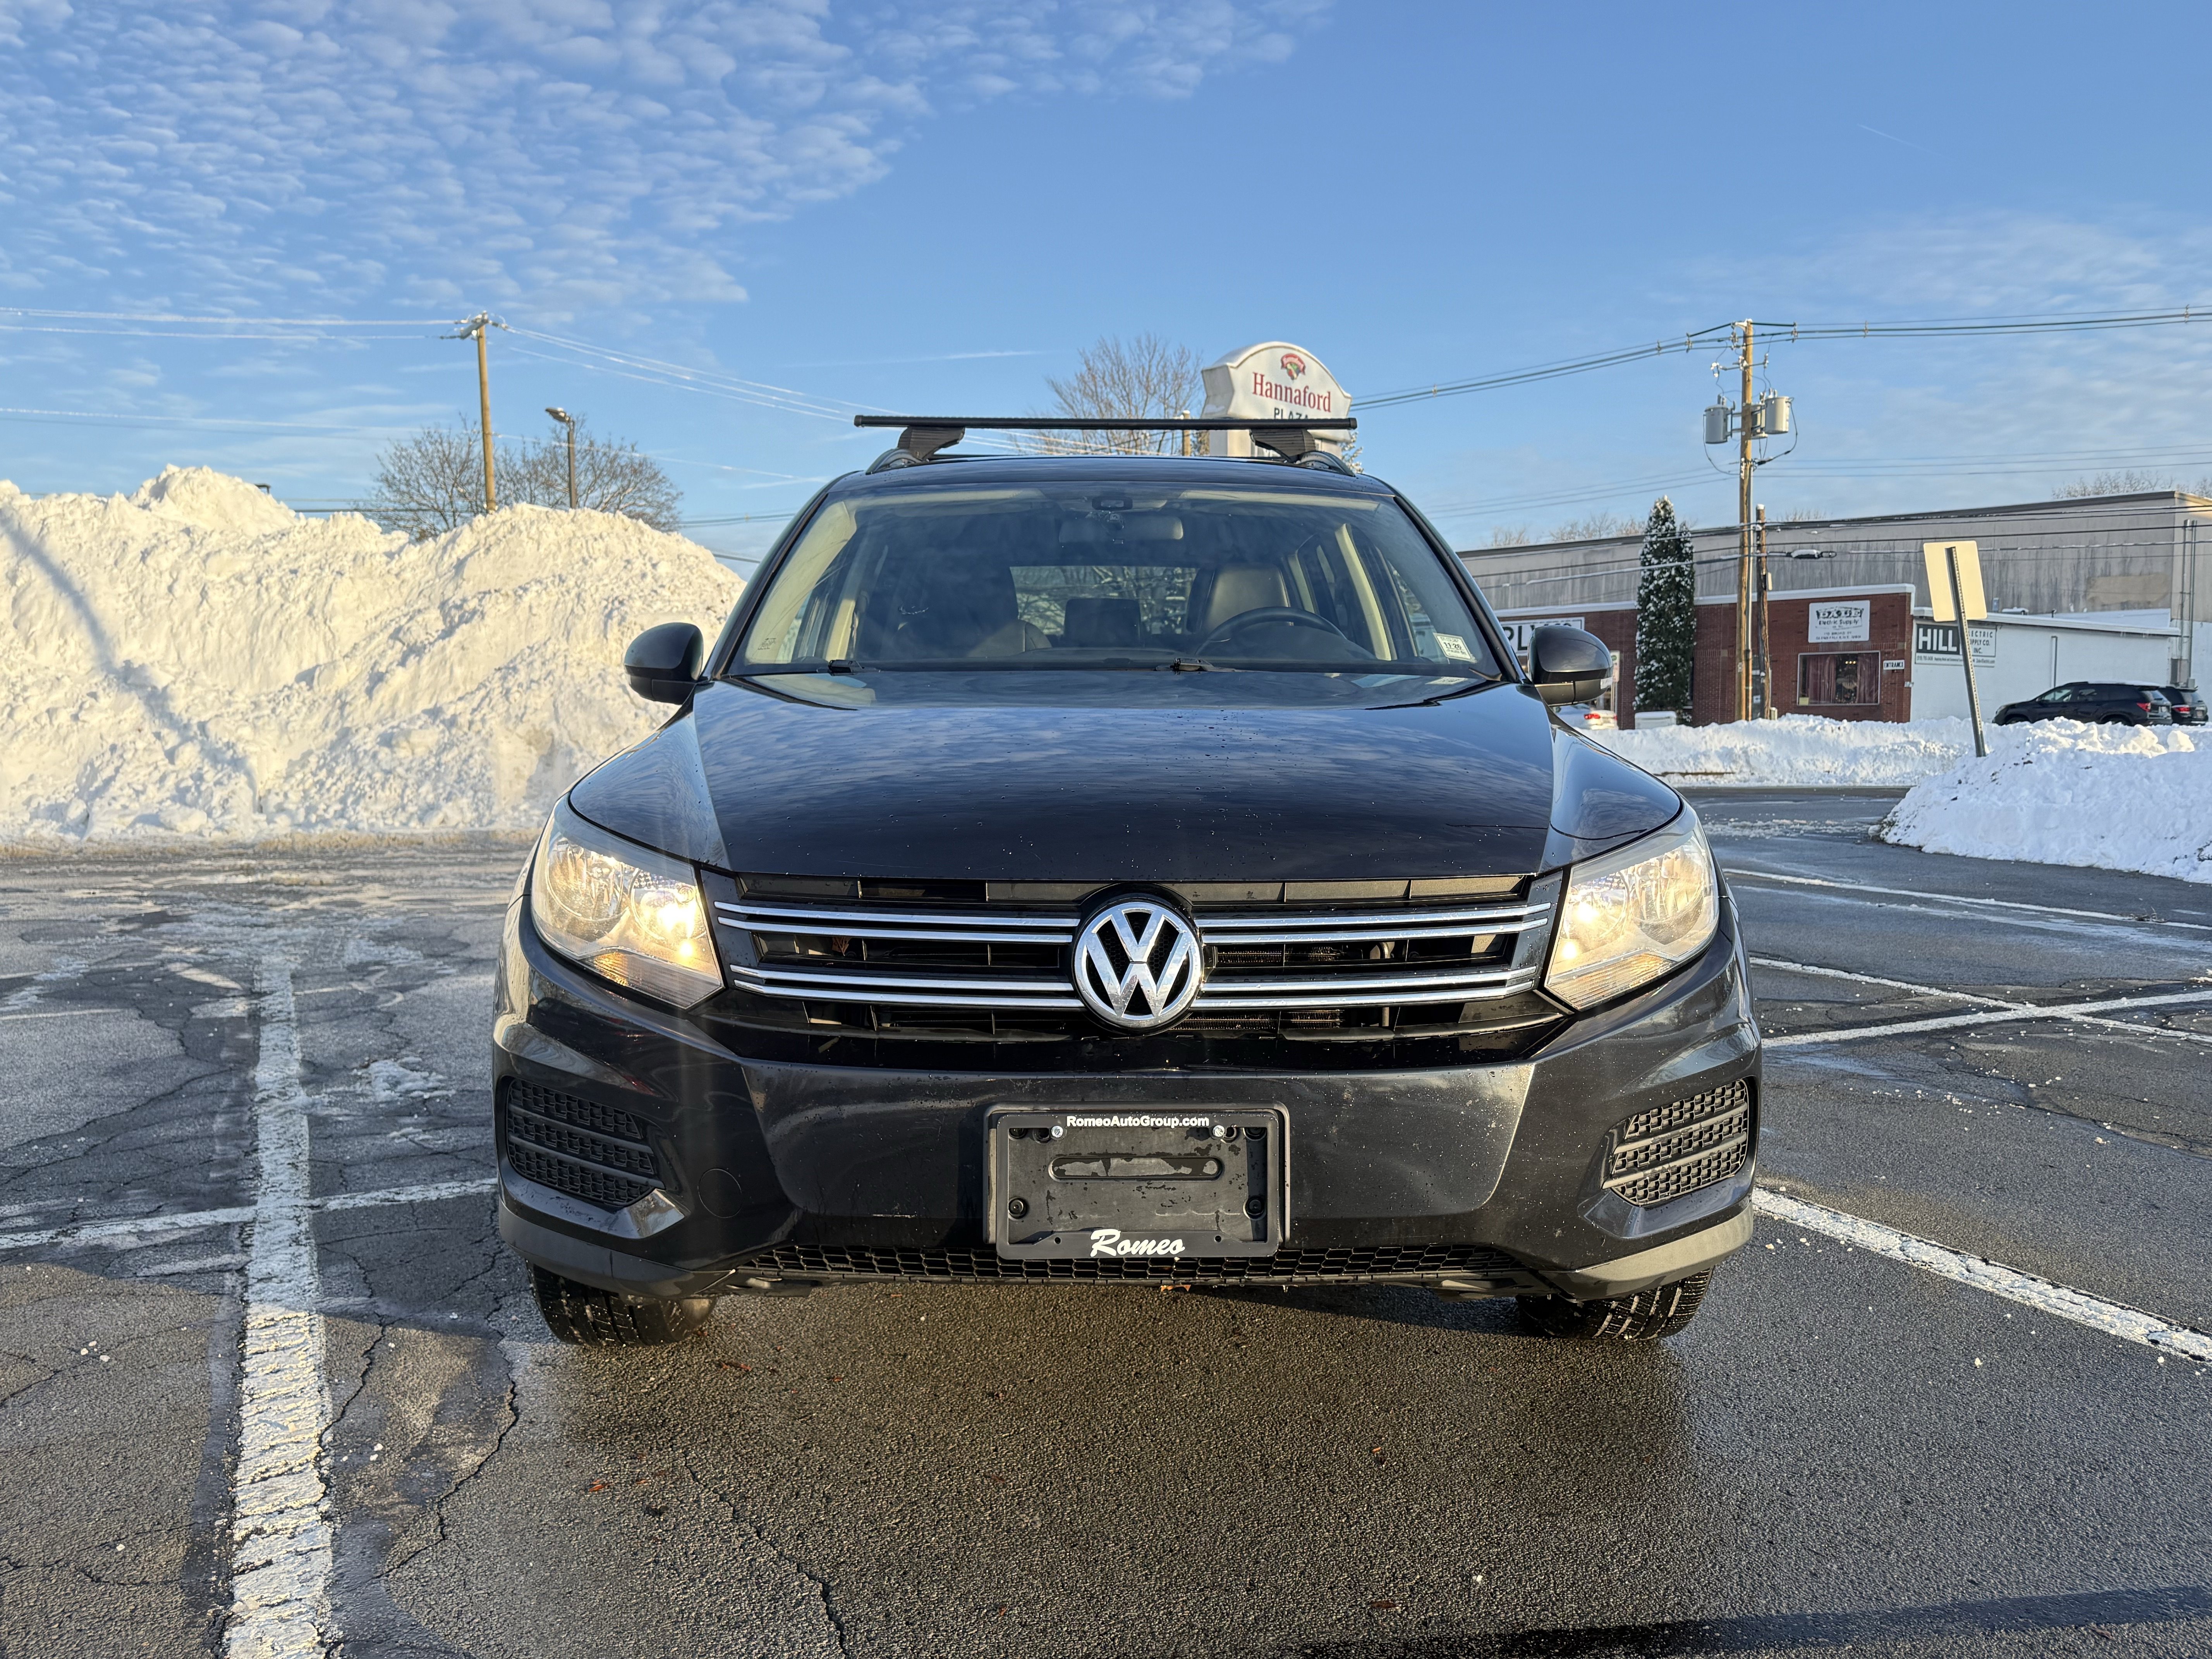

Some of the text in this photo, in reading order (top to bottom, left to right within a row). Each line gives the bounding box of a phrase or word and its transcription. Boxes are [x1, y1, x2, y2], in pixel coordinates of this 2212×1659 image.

[1252, 371, 1331, 413] Hannaford
[1918, 628, 1957, 652] HILL
[1066, 1115, 1209, 1128] RomeoAutoGroup.com
[1090, 1229, 1185, 1257] Romeo
